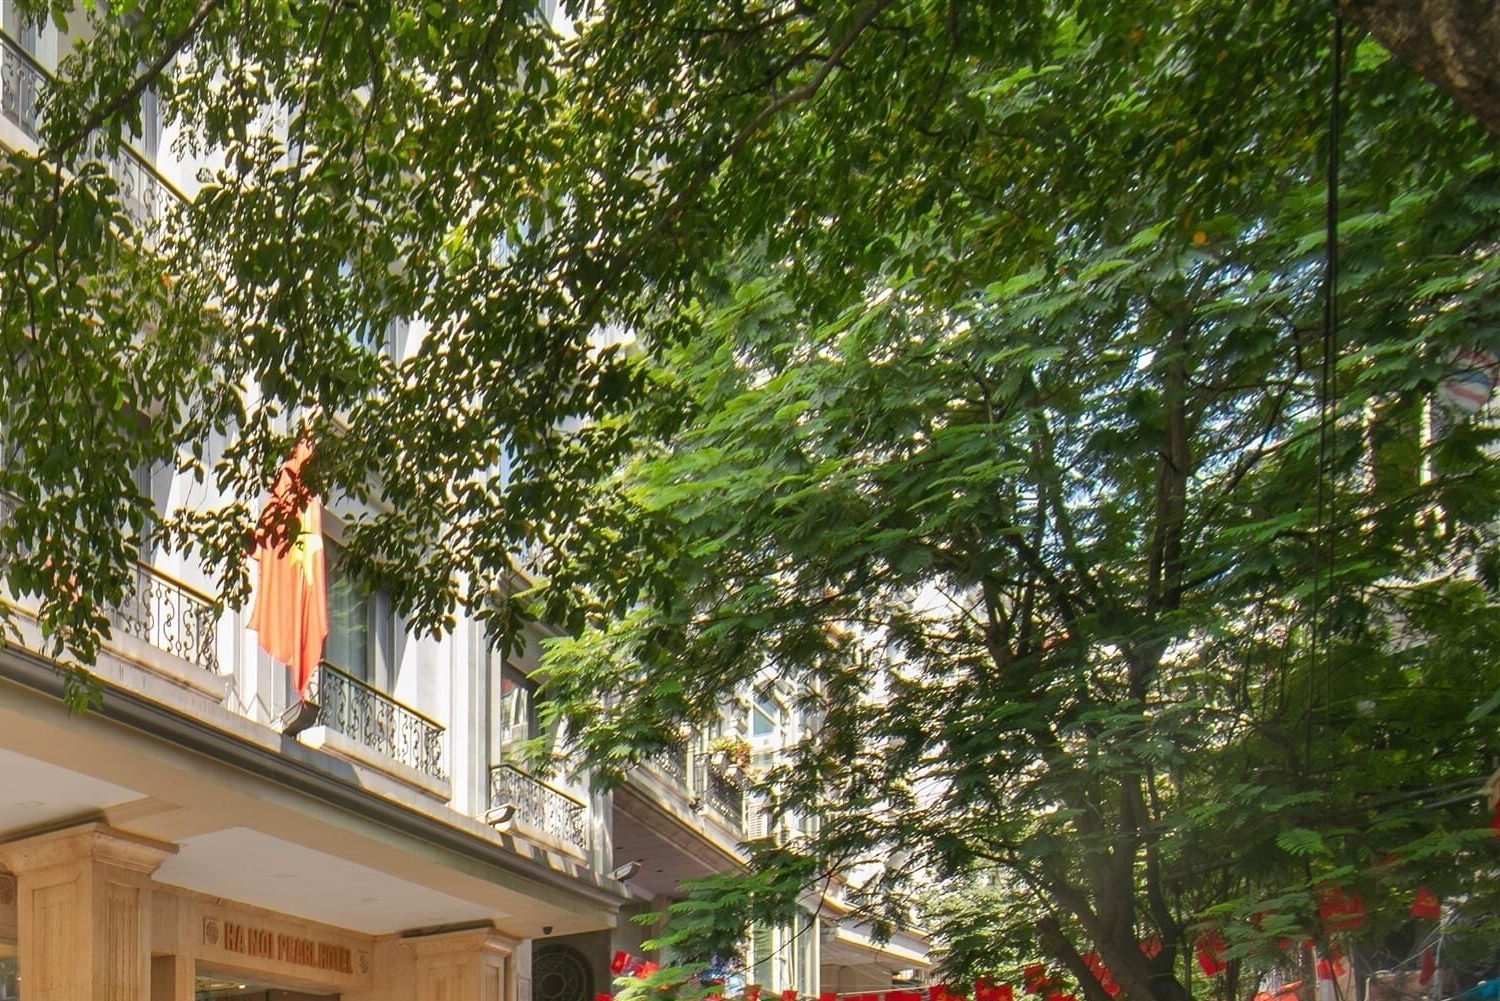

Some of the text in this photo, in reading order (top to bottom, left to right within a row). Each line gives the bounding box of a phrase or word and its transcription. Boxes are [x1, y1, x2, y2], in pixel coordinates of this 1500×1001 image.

[224, 922, 245, 954] HA
[277, 934, 317, 969] PEARL
[317, 941, 354, 975] HOTEL
